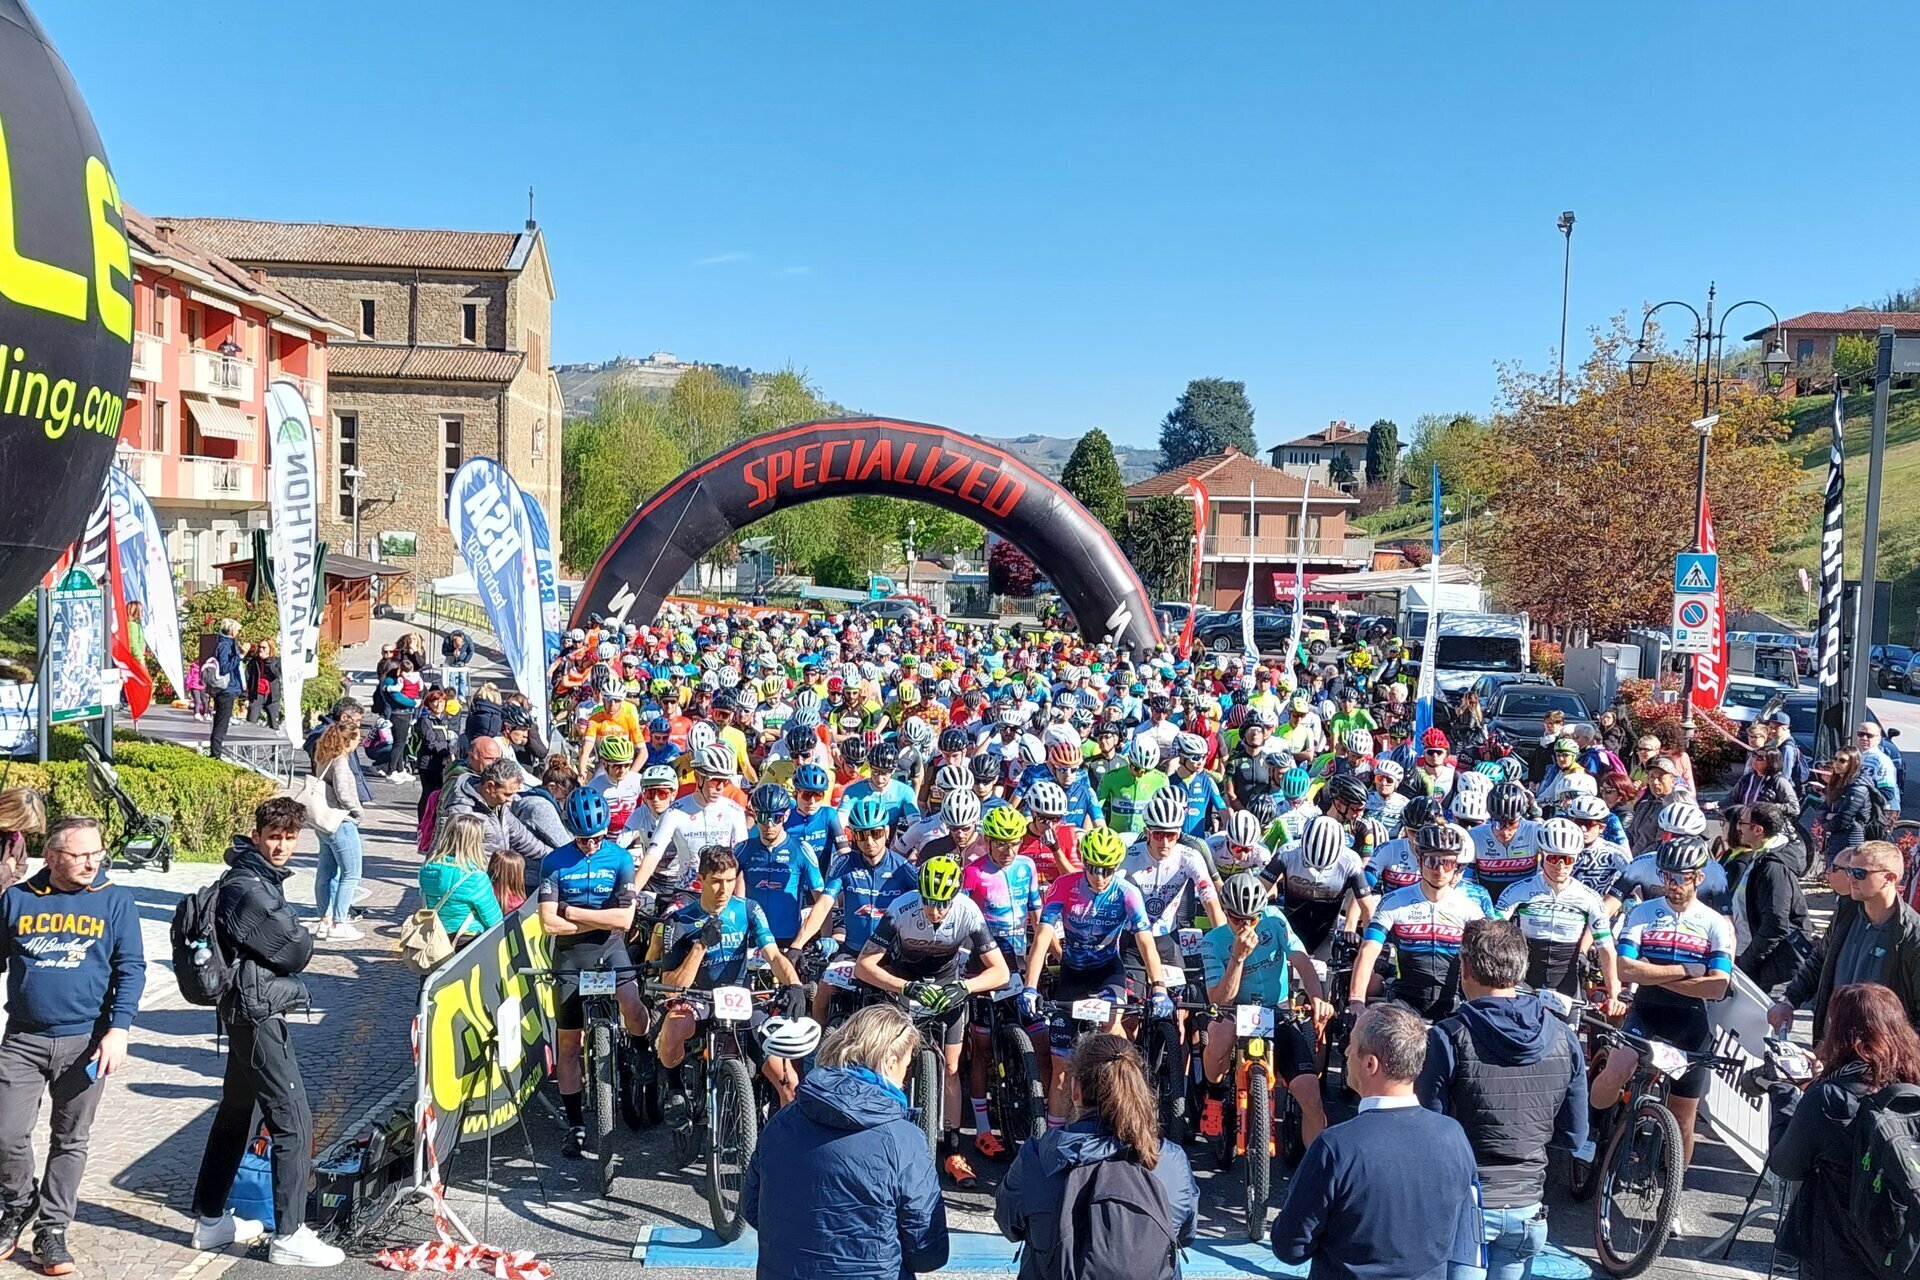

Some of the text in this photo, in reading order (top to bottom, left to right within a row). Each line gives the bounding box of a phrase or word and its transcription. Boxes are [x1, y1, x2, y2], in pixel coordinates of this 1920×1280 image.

[743, 439, 1028, 519] SPECIALIZED
[1479, 856, 1536, 868] SILMAX
[18, 912, 105, 939] R.COACH
[1399, 923, 1464, 937] SILMAX
[1180, 933, 1197, 947] 54
[834, 966, 853, 980] 49
[723, 993, 745, 1009] 62
[1251, 1012, 1262, 1026] 6
